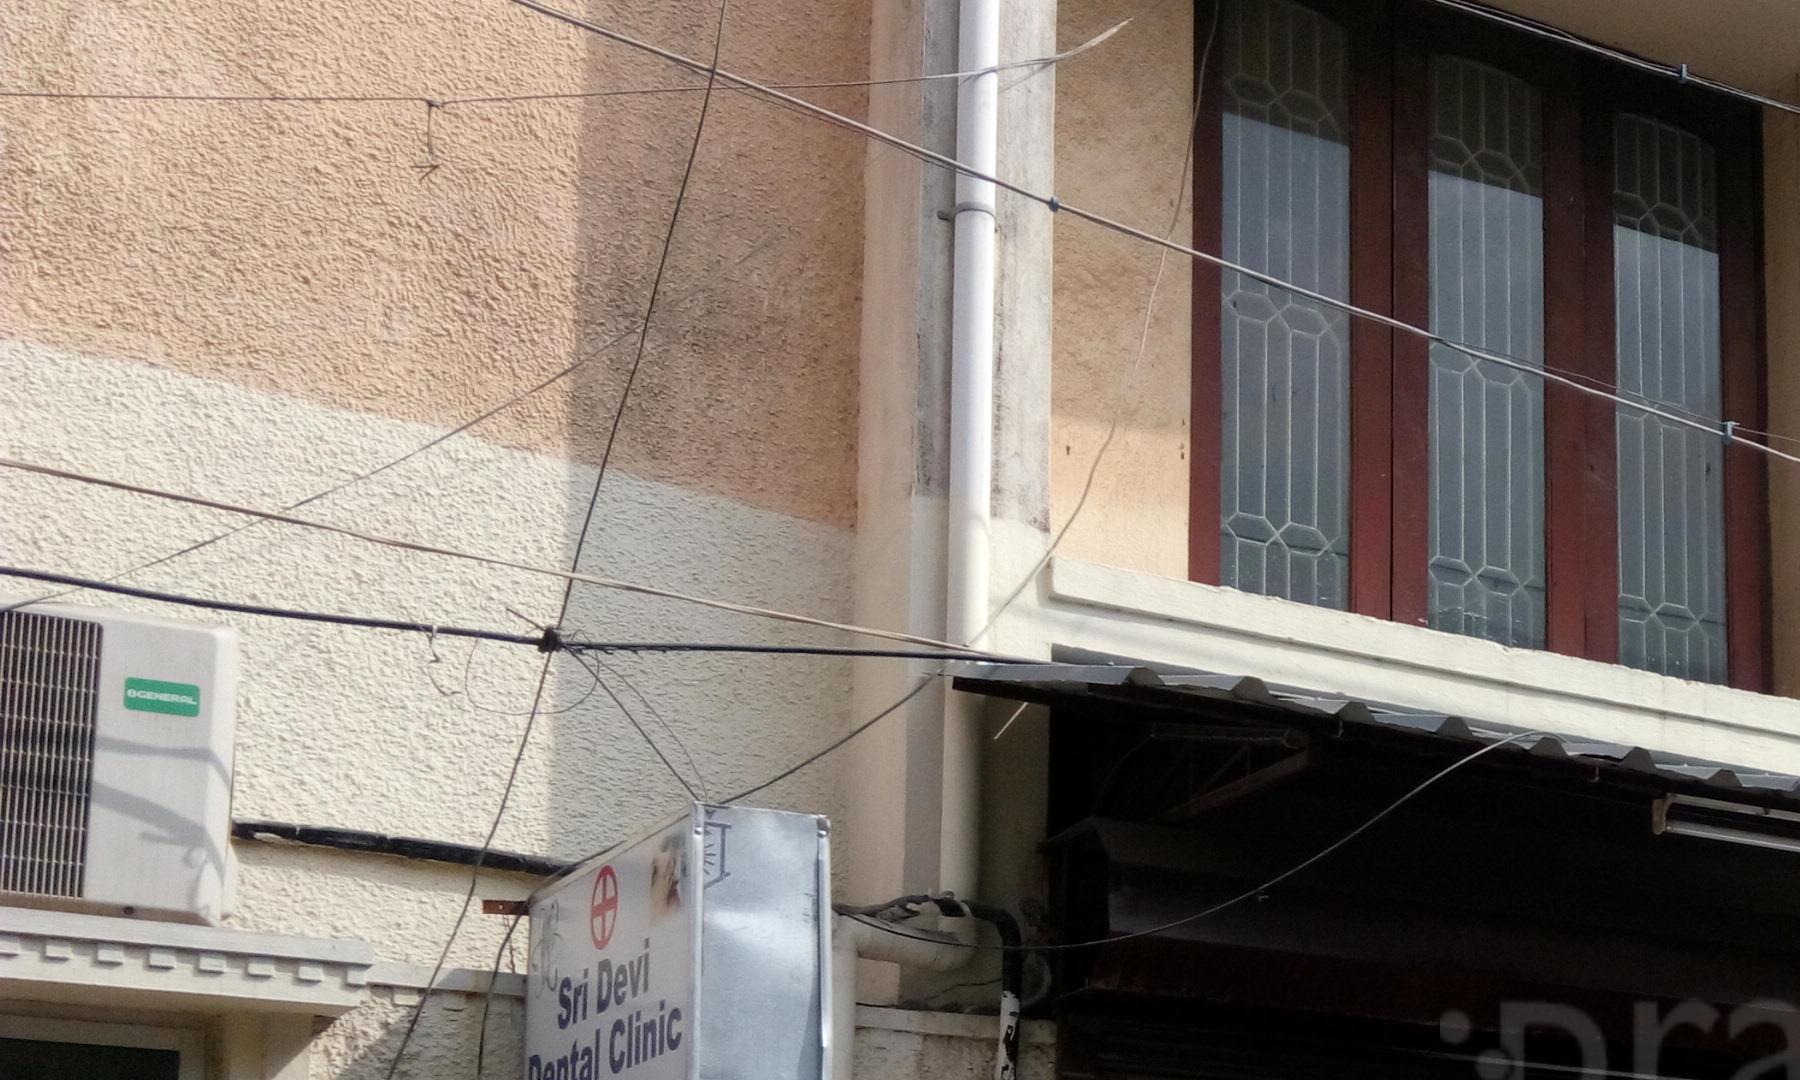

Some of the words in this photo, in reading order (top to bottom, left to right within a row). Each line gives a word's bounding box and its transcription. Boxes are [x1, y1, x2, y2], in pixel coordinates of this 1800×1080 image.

[557, 967, 589, 1030] Sri
[596, 937, 650, 1014] Devi
[610, 999, 682, 1074] Clinic
